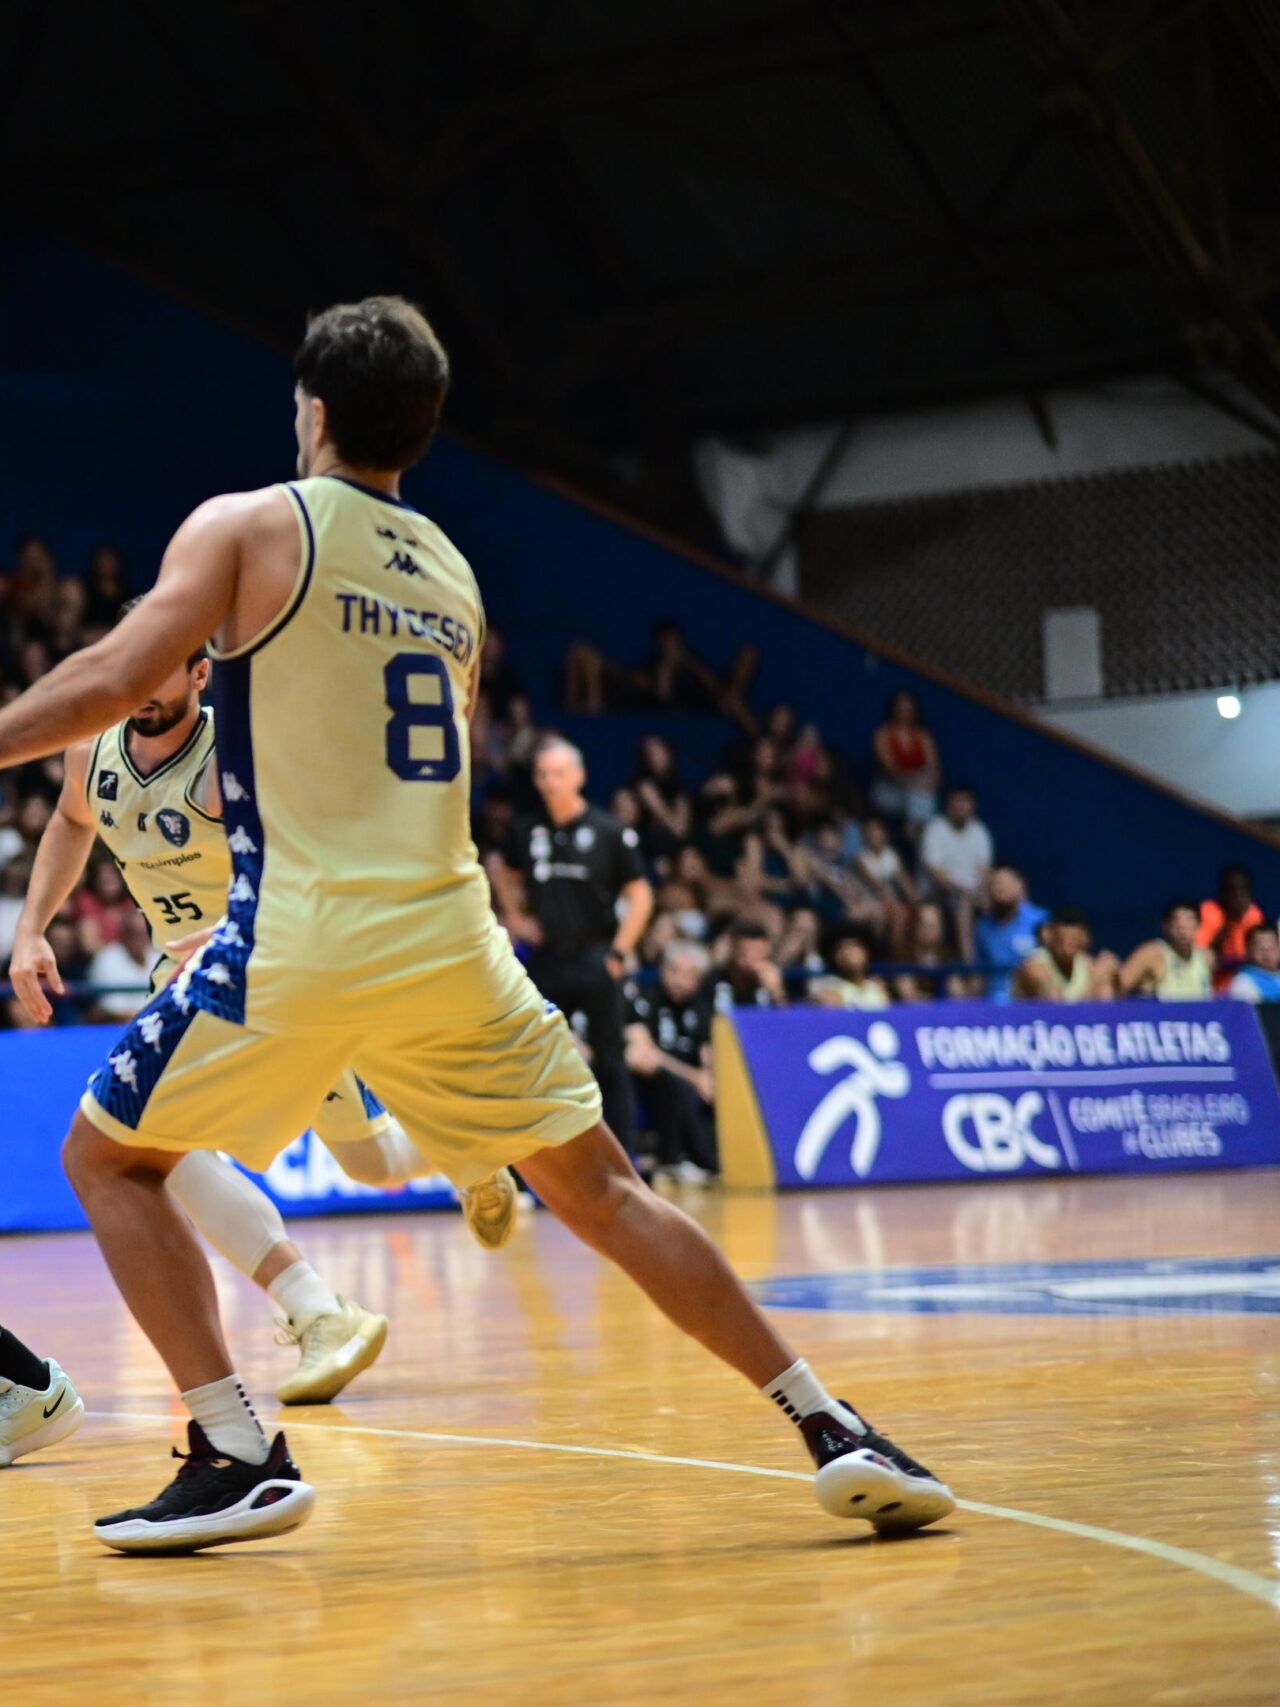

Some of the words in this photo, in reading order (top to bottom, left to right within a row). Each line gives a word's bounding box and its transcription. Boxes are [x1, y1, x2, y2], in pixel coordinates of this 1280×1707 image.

[383, 652, 461, 783] 8
[152, 892, 203, 924] 35
[915, 1020, 1077, 1074] FORMAÇÃO
[1074, 1023, 1117, 1066] DE
[1116, 1021, 1231, 1063] ATLETAS
[942, 1090, 1061, 1172] CBC
